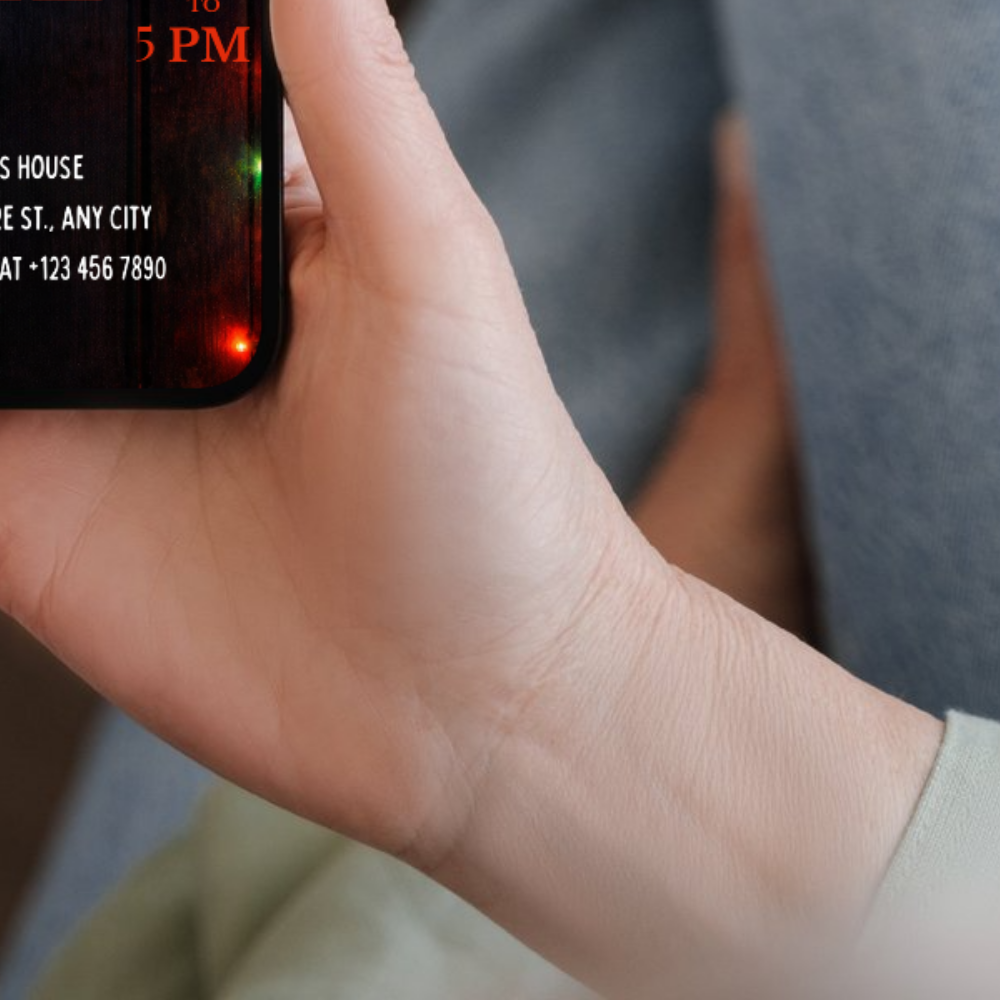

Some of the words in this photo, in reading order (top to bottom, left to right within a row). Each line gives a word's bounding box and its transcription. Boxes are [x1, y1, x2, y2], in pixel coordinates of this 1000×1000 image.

[136, 24, 156, 63] 5
[169, 26, 251, 63] PM
[18, 154, 84, 180] HOUSE
[20, 205, 55, 233] ST.,
[61, 205, 104, 231] ANY
[110, 205, 152, 231] CITY
[29, 255, 71, 281] +123
[77, 255, 114, 281] 456
[119, 255, 167, 281] 7890
